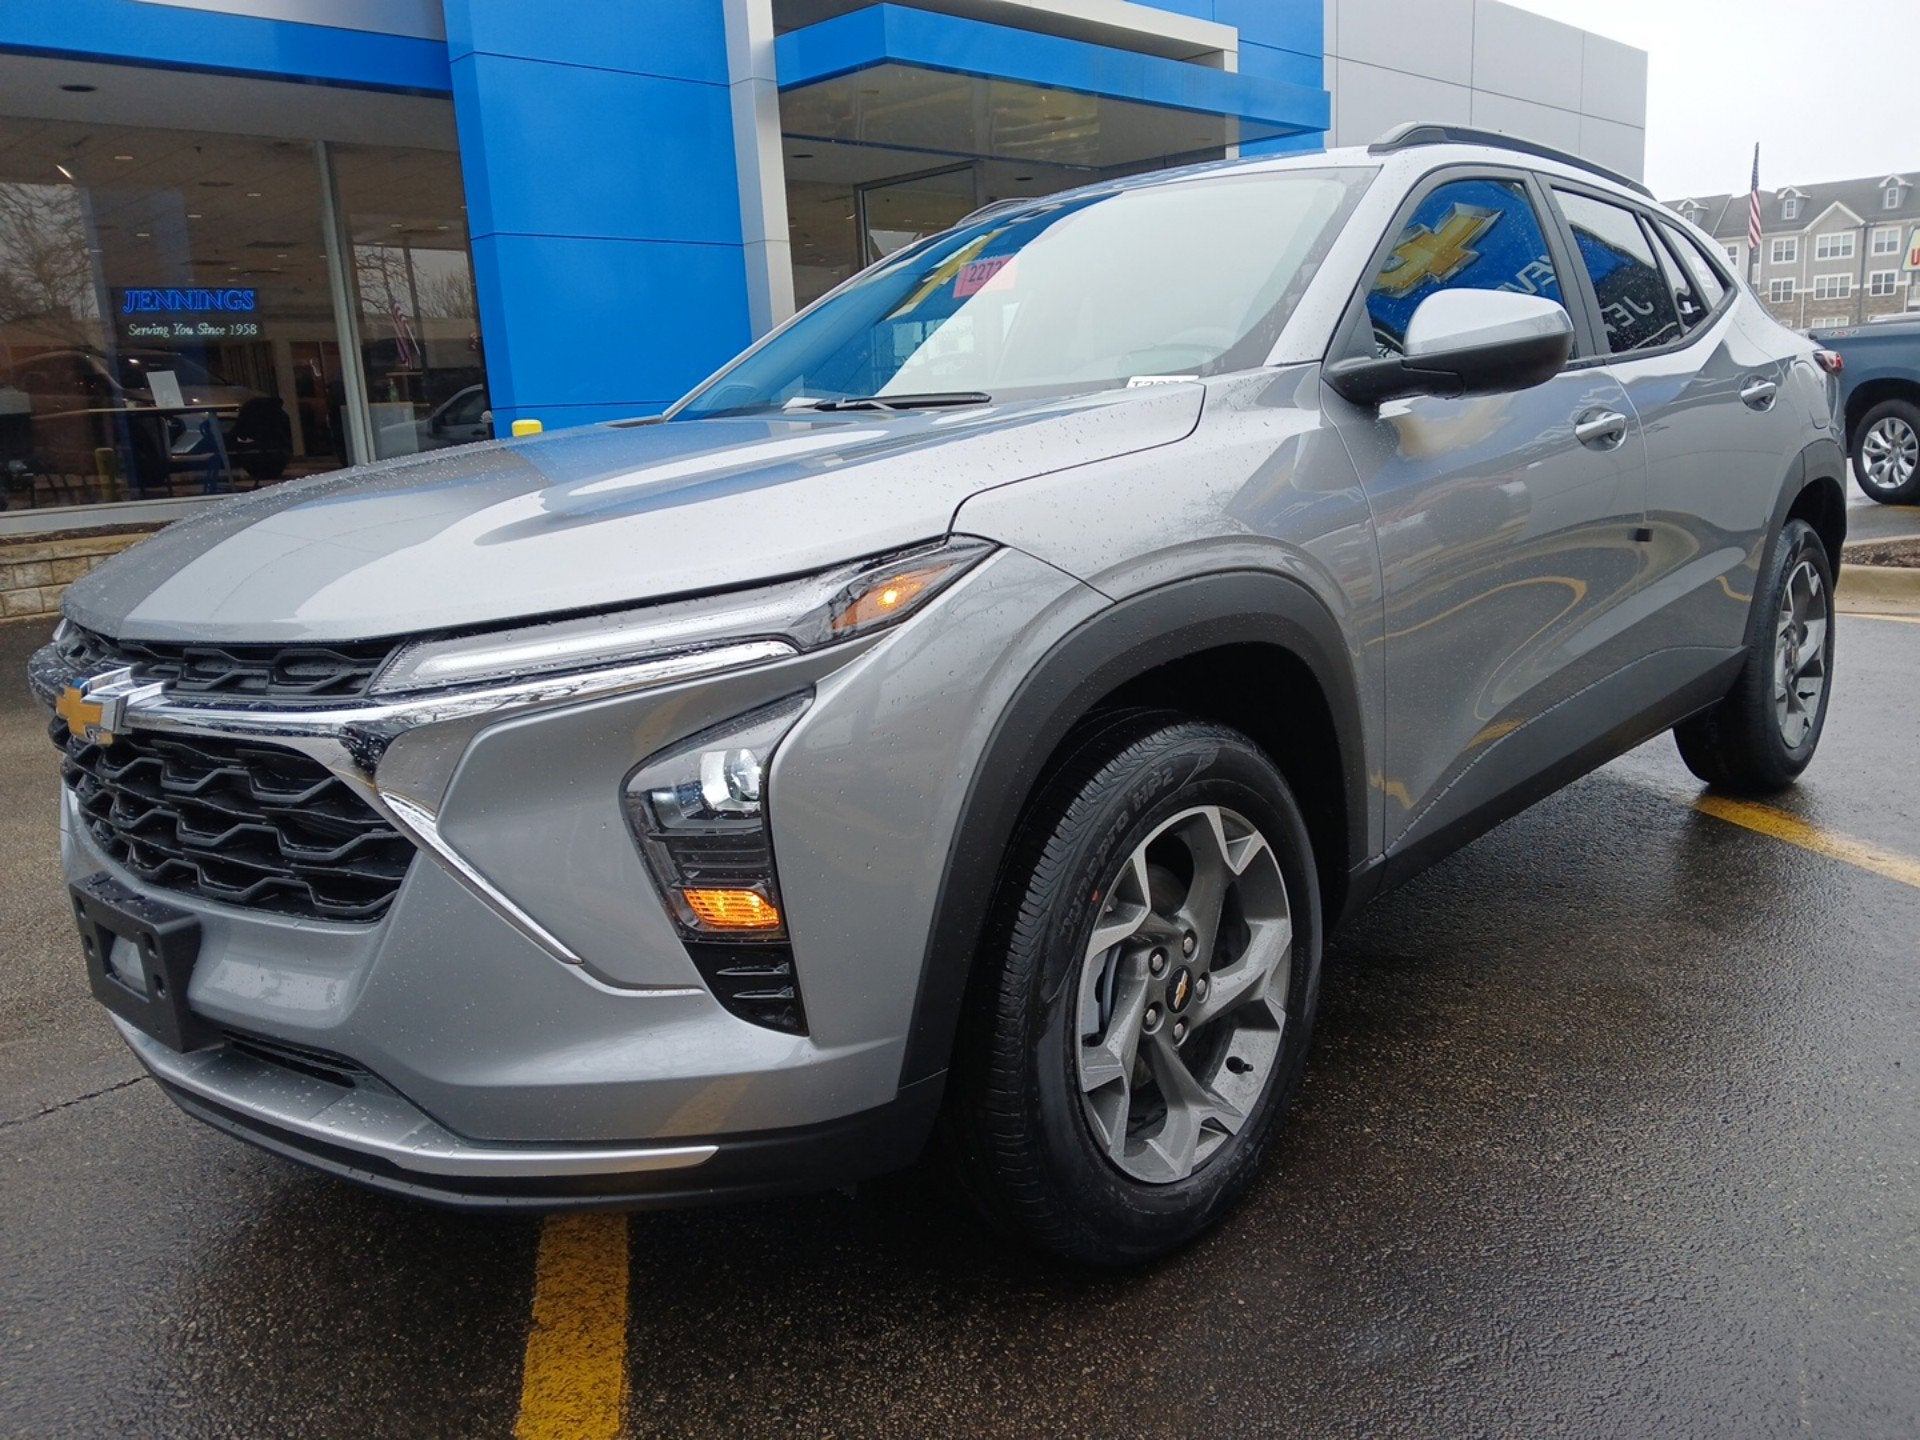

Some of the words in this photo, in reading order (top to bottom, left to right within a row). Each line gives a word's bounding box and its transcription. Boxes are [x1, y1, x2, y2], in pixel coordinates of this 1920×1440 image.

[122, 289, 255, 314] JENNINGS
[128, 322, 170, 338] Serving
[173, 323, 194, 336] You
[196, 322, 226, 336] Since
[229, 323, 257, 336] 1958
